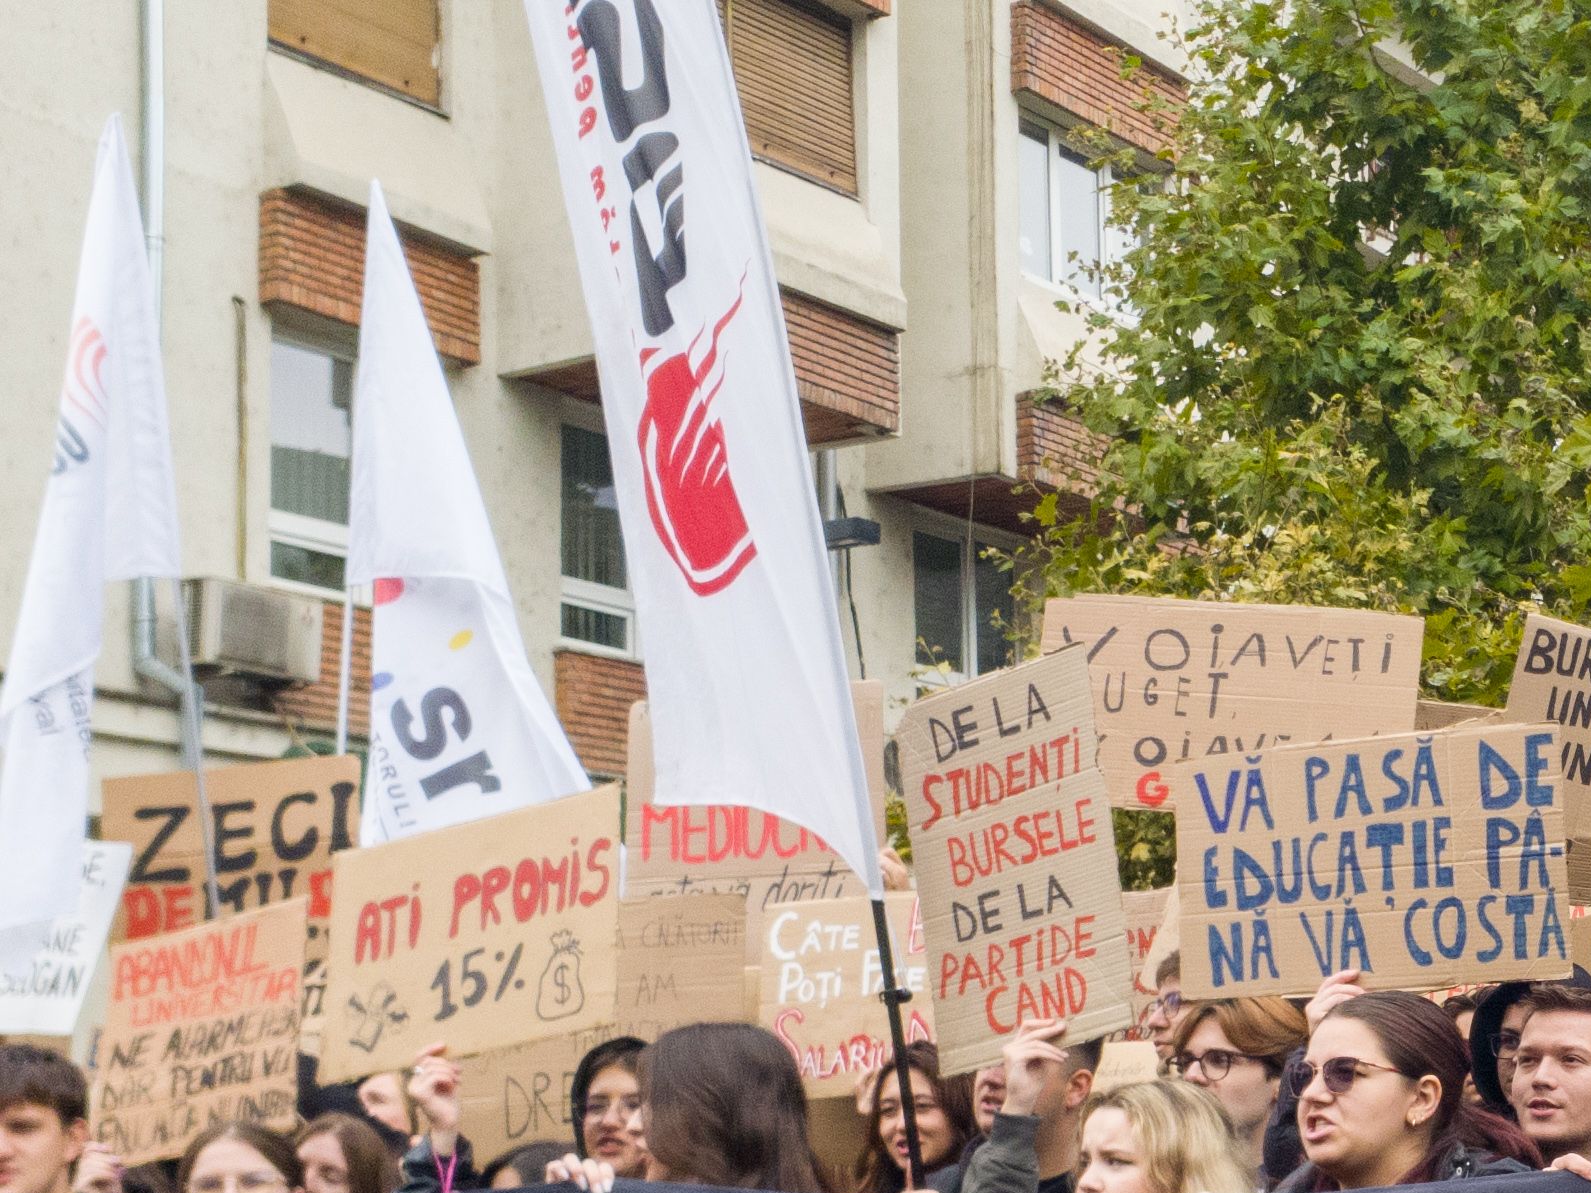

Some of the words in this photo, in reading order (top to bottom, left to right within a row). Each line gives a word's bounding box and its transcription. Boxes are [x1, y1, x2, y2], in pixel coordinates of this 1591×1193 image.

[929, 705, 980, 764] DE
[992, 683, 1051, 738] LA
[1103, 671, 1237, 720] UGET,
[1194, 754, 1275, 834] VĂ
[1304, 735, 1445, 824] PASĂ
[1478, 732, 1555, 810] DE
[129, 782, 355, 883] ZECI
[947, 798, 1097, 888] BURSELE
[1203, 816, 1455, 912] EDUCAȚIE
[123, 885, 193, 940] DE
[769, 911, 861, 961] CÂTE
[952, 889, 1003, 943] DE
[1016, 875, 1073, 921] LA
[1207, 908, 1280, 989] NĂ
[1300, 898, 1375, 978] VĂ
[430, 941, 525, 1022] 15%
[984, 966, 1088, 1035] CAND
